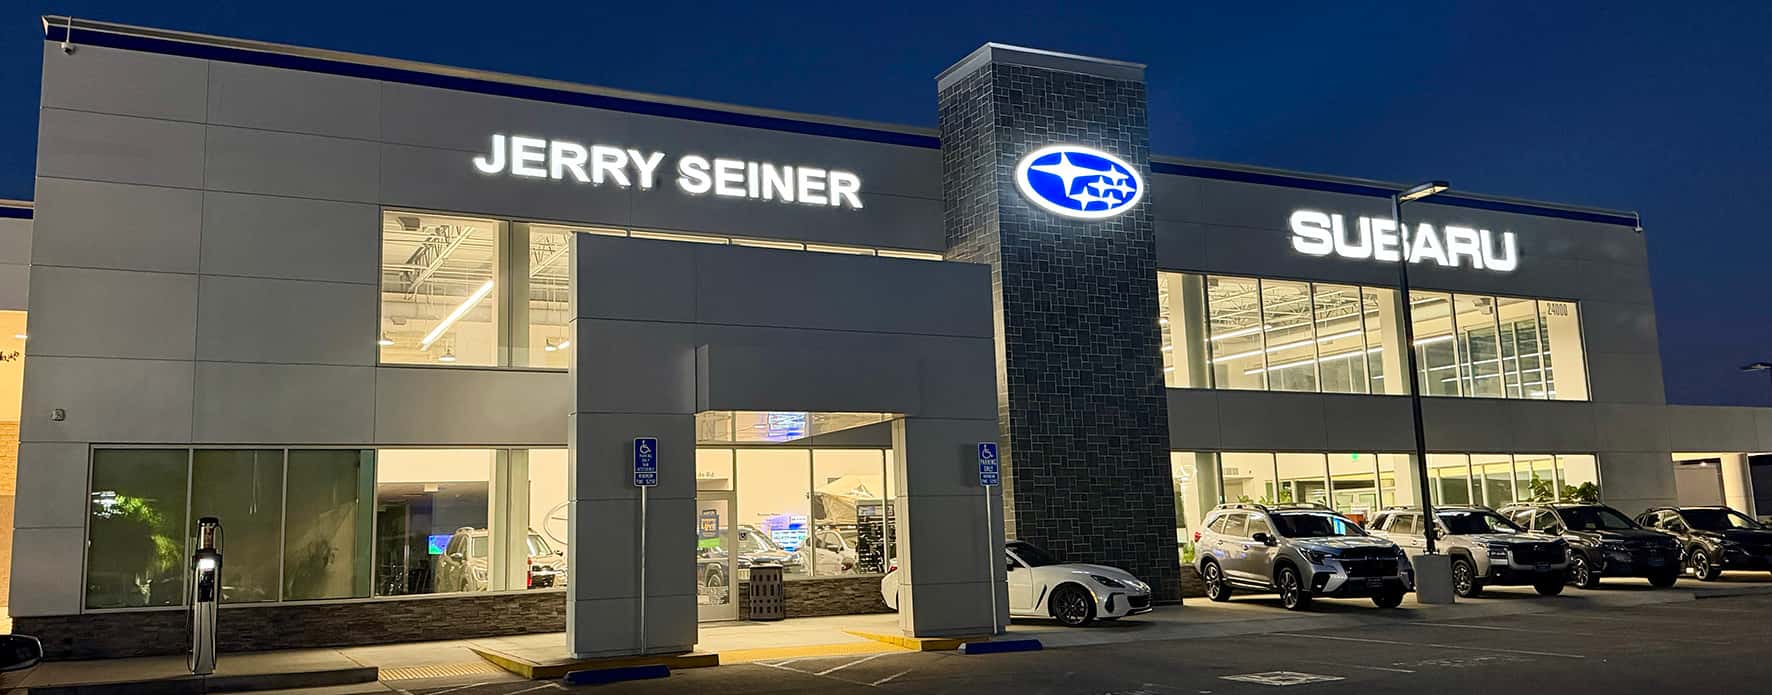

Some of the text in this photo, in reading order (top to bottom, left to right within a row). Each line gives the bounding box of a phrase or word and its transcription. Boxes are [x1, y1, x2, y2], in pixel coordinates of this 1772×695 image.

[472, 133, 864, 210] JERRY SEINER
[1290, 209, 1518, 273] SUBARU
[1546, 302, 1568, 317] 24000
